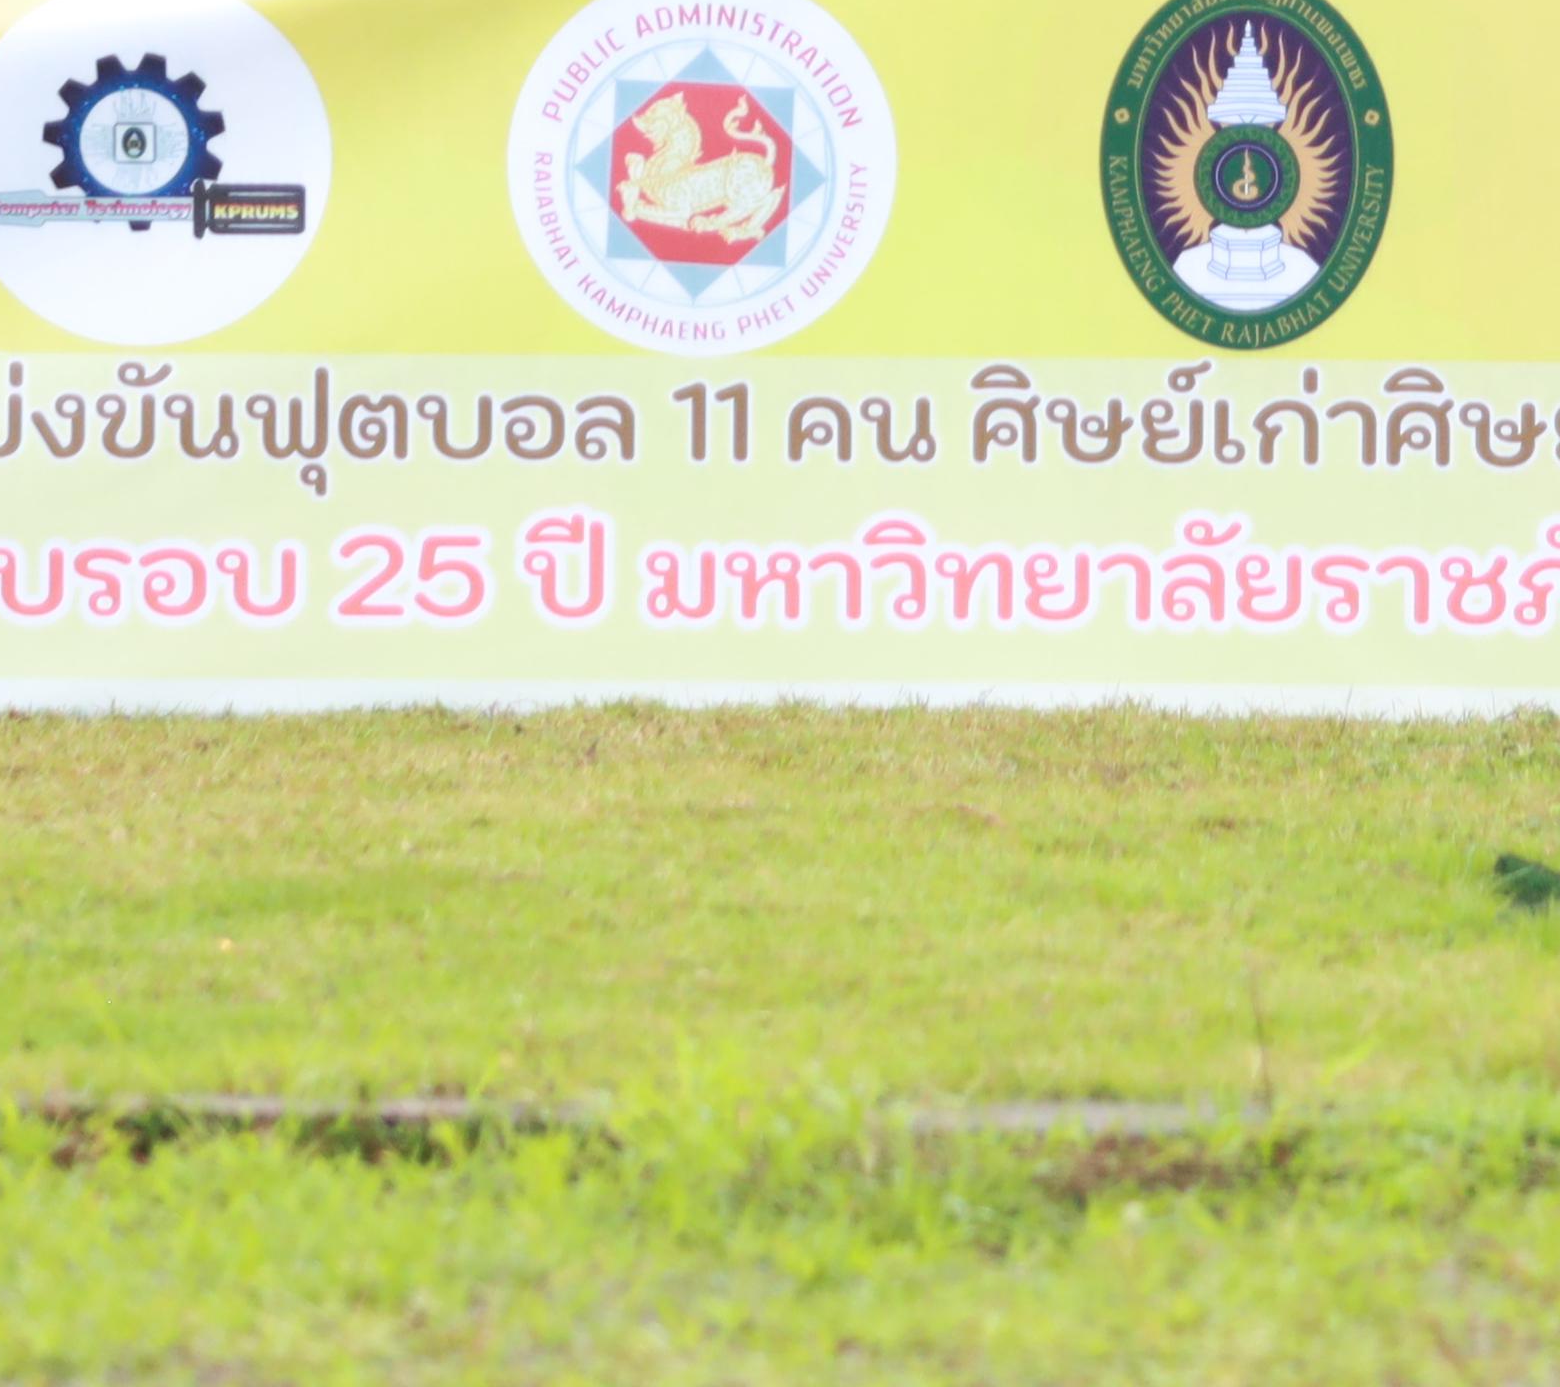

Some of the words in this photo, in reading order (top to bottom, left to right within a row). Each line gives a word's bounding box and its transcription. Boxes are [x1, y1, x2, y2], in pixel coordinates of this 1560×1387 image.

[541, 26, 625, 123] PUBLIC
[634, 2, 864, 130] ADMINISTRATION
[84, 198, 194, 221] Technology
[213, 202, 300, 220] KPRUMS
[578, 272, 727, 342] KAMPHAENG
[736, 294, 797, 336] PHET
[799, 162, 869, 300] UNIVERSITY
[1108, 154, 1167, 293] KAMPHAENG
[1161, 291, 1217, 336] PHET
[1220, 290, 1333, 348] RAJABHAT
[1335, 162, 1386, 294] UNIVERSITY
[674, 382, 751, 461] 11
[786, 393, 937, 466] คน
[337, 533, 486, 618] 25
[523, 514, 608, 618] ปี
